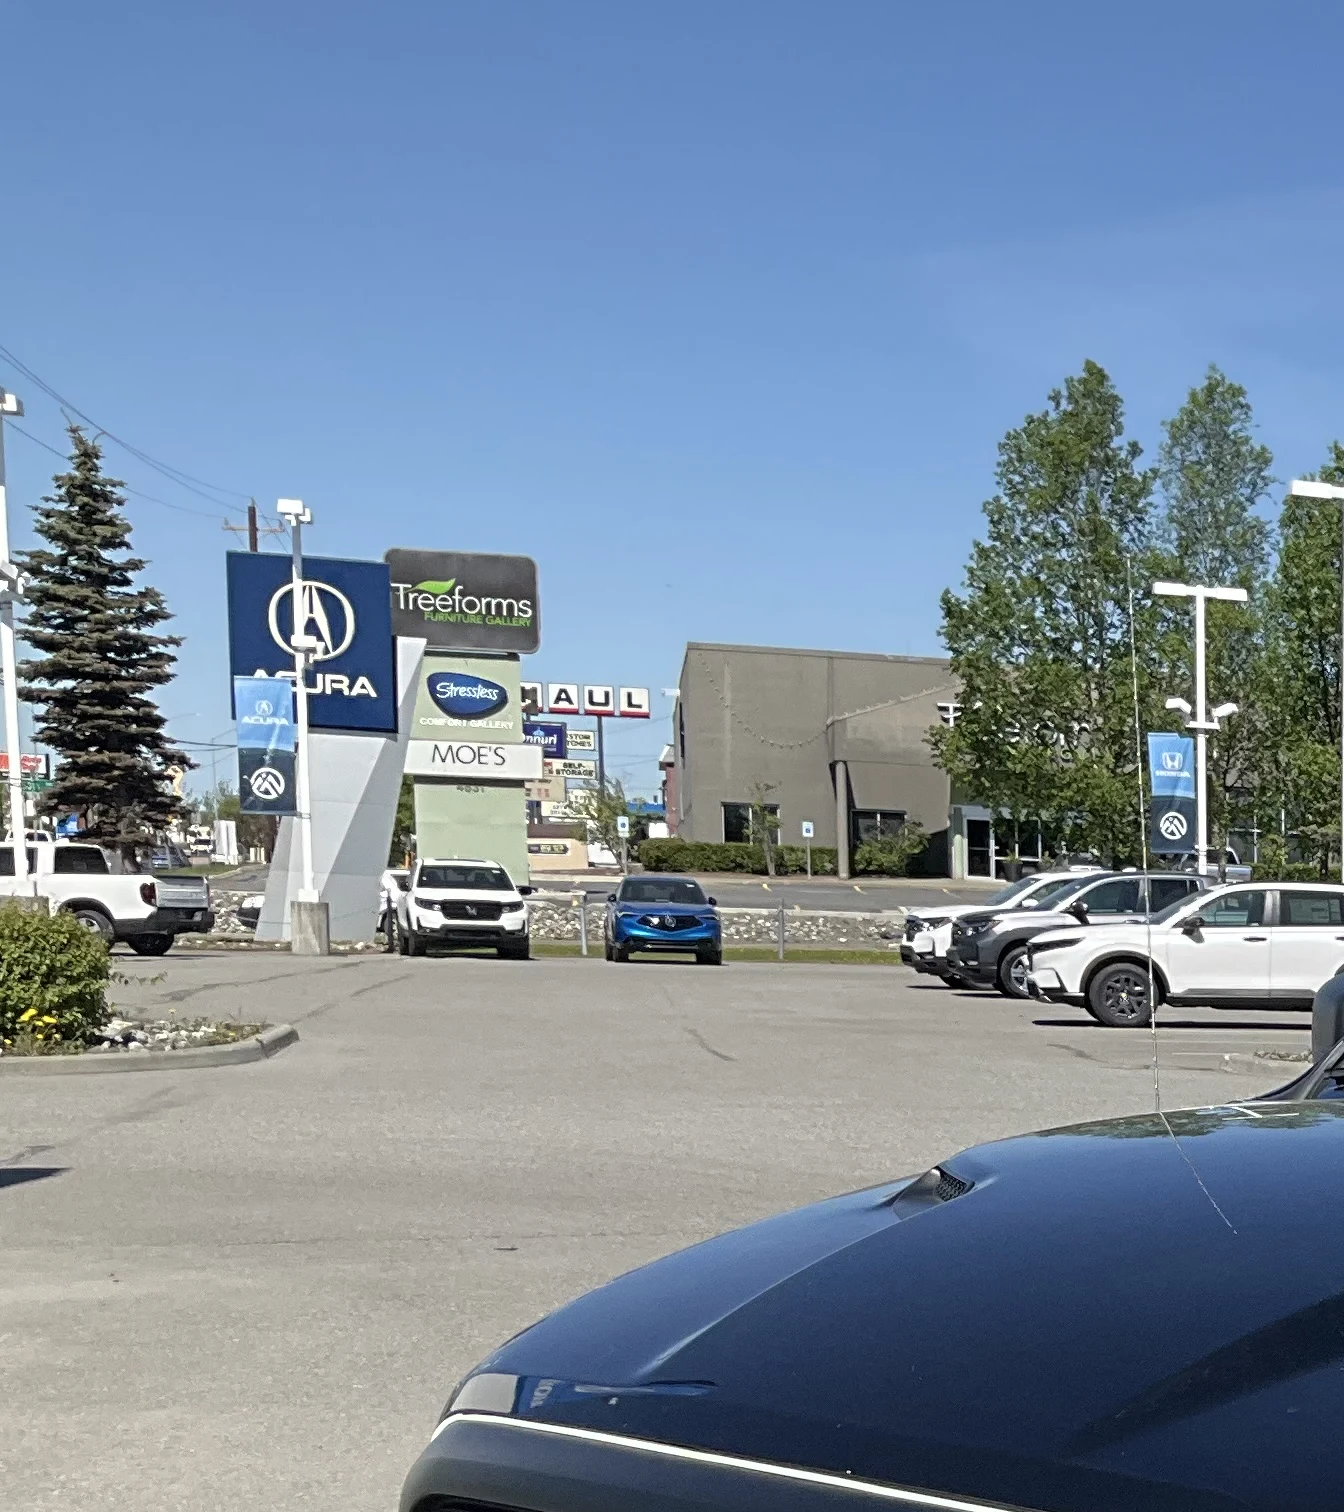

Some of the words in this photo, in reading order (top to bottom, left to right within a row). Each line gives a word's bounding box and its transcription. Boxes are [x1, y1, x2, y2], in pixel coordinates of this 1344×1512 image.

[391, 582, 533, 618] Treeforms
[424, 612, 483, 625] FURNITURE
[485, 616, 532, 627] GALLERY
[436, 682, 499, 701] Stressless
[241, 715, 289, 726] ACURA
[419, 717, 467, 727] COMFORT
[470, 719, 514, 730] GALLERY
[523, 733, 558, 745] nnuri
[431, 744, 506, 766] MOE'S
